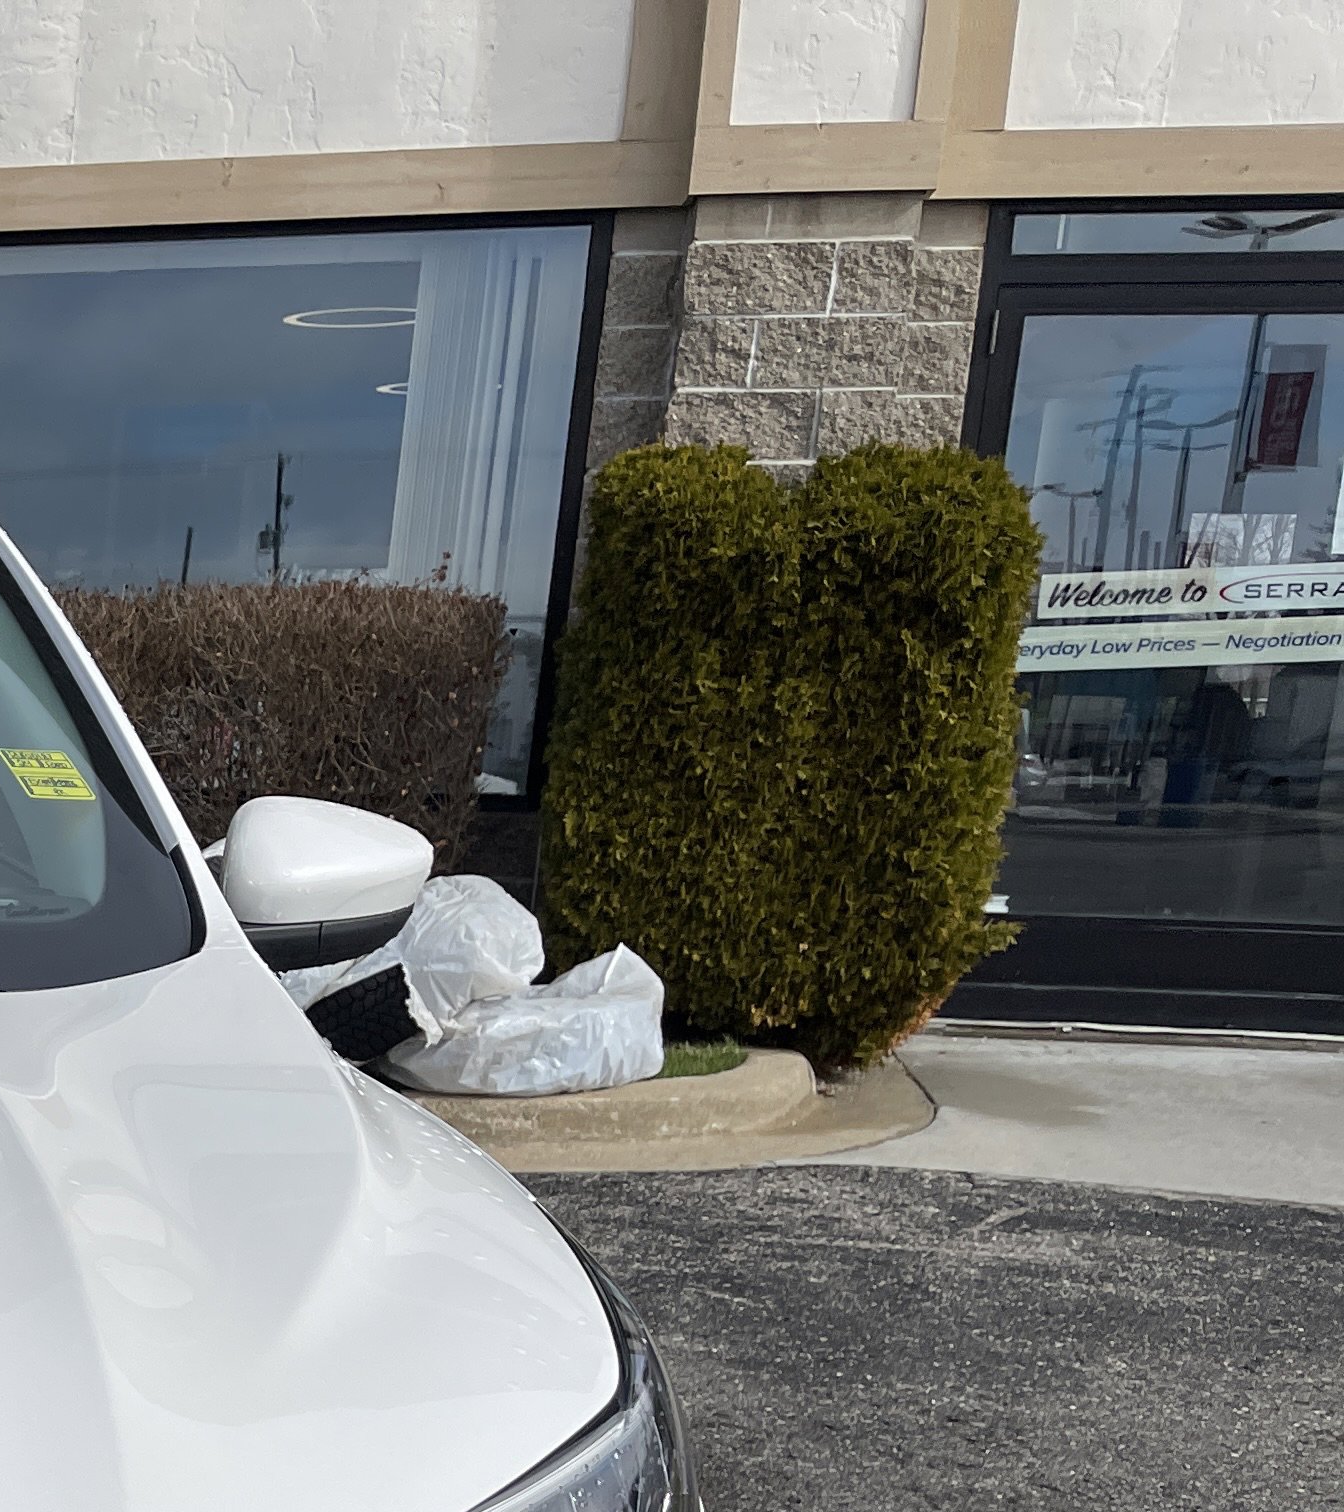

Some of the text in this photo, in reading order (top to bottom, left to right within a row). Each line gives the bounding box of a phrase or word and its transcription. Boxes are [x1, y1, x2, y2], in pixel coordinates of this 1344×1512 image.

[1047, 581, 1172, 608] Welcome
[1181, 578, 1207, 603] to
[1019, 640, 1087, 659] eryday
[1090, 639, 1132, 654] Low
[1136, 636, 1196, 652] Prices
